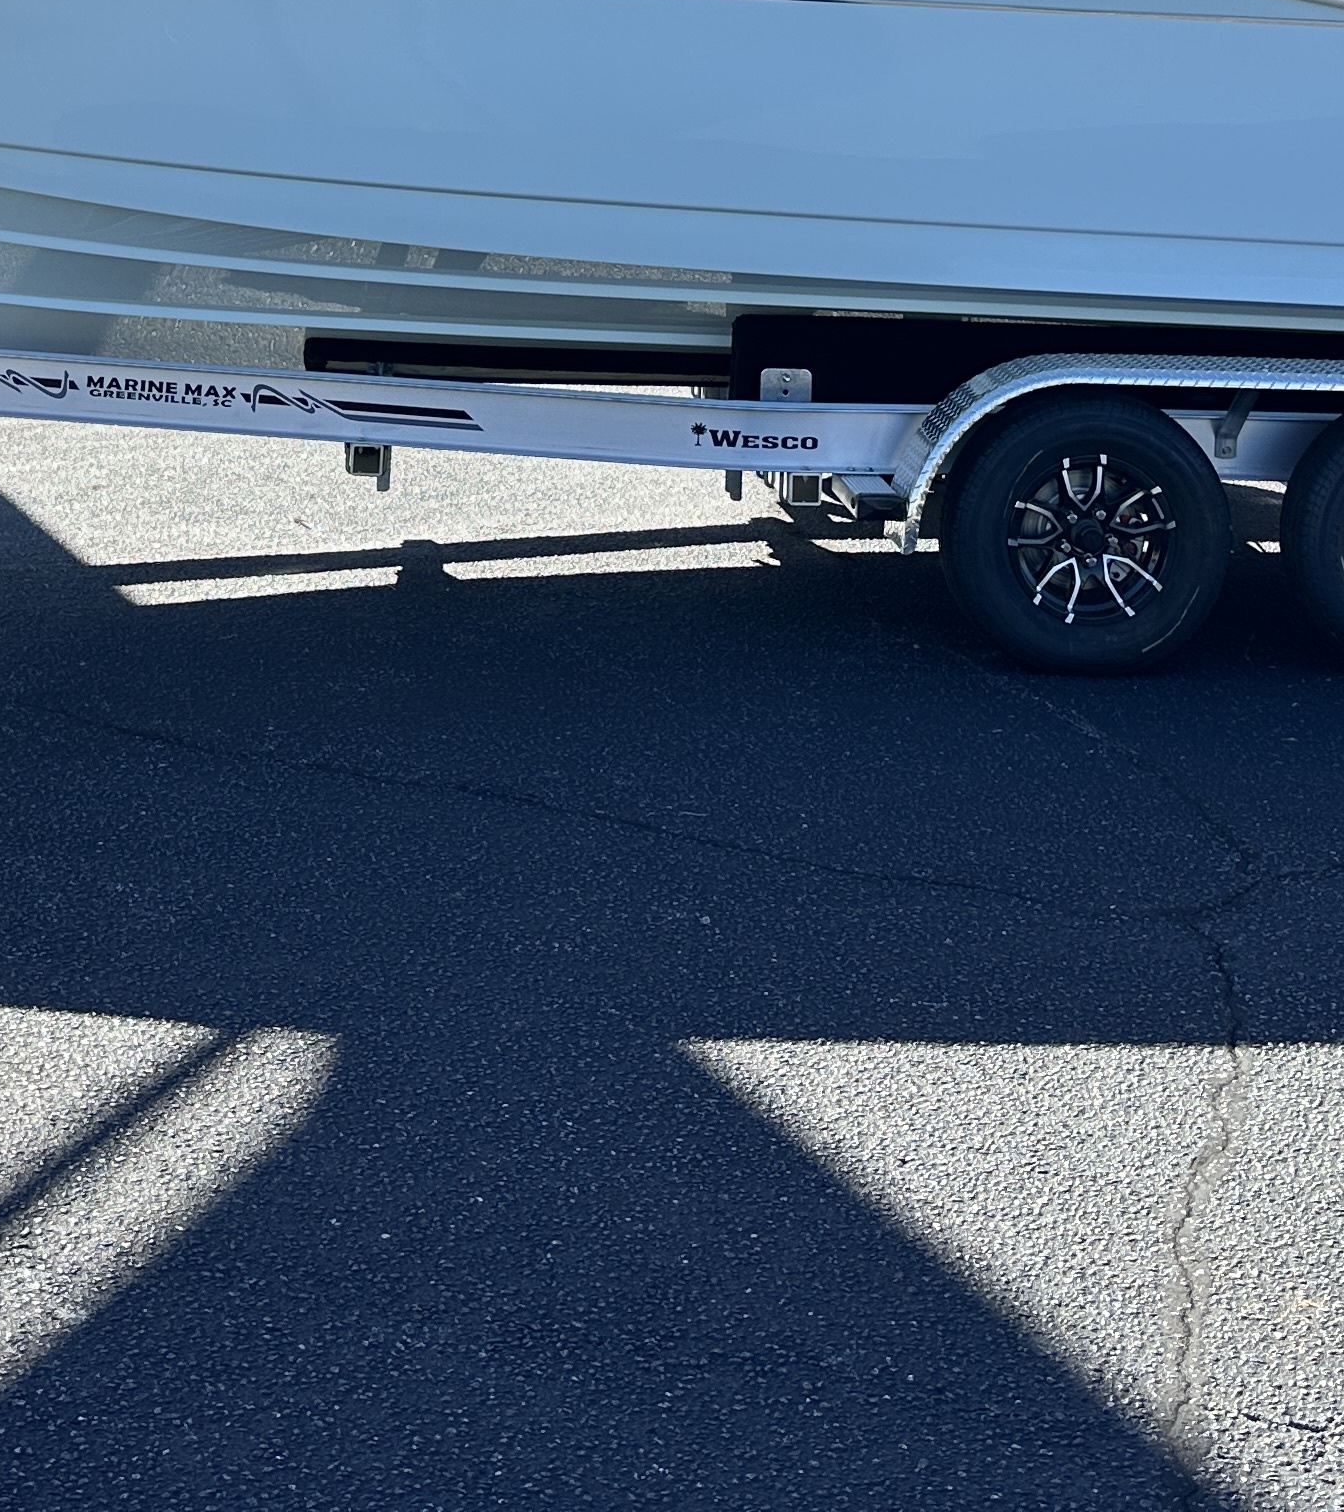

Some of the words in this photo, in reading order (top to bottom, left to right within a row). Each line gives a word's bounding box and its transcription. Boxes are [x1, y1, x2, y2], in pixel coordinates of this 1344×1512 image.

[86, 375, 178, 394] MARINE
[184, 383, 237, 400] MAX
[89, 388, 208, 407] GREENVILLE,
[212, 398, 233, 408] SC
